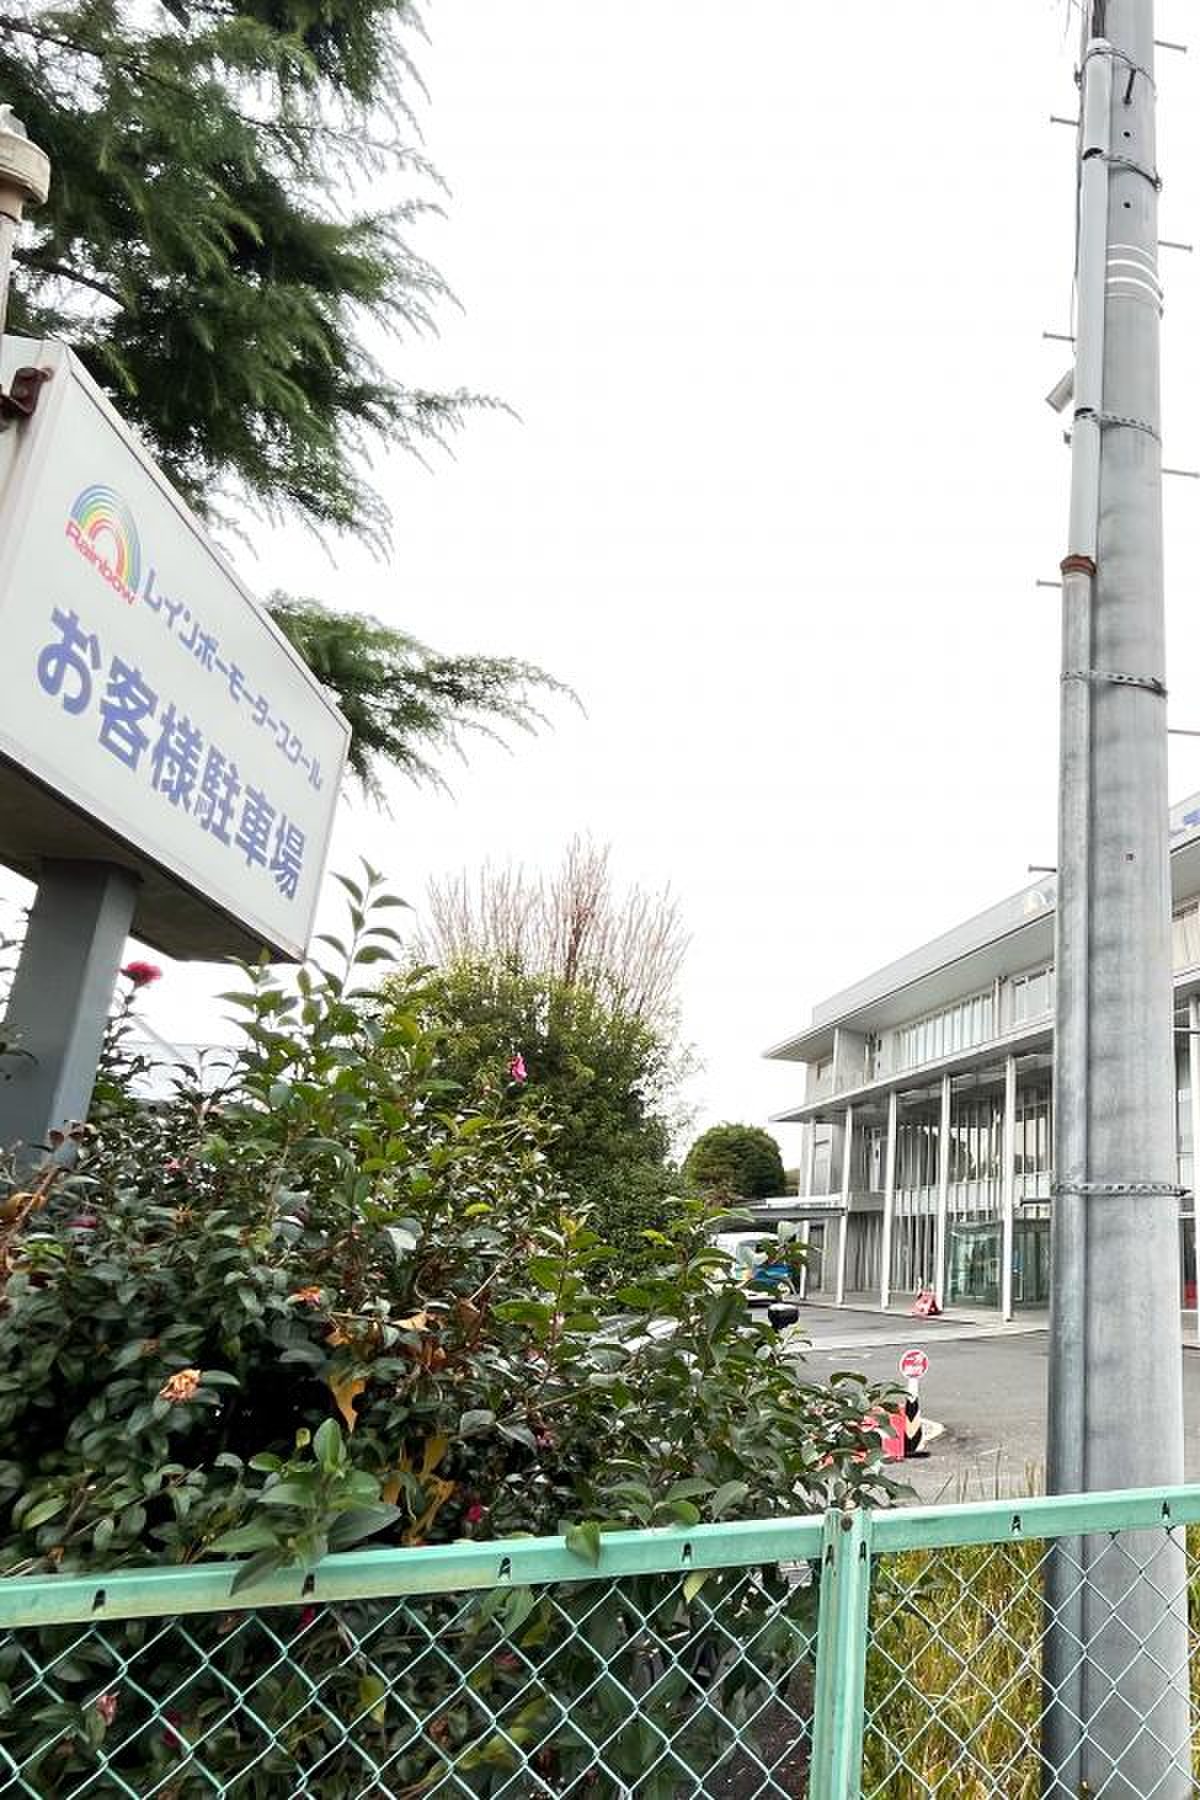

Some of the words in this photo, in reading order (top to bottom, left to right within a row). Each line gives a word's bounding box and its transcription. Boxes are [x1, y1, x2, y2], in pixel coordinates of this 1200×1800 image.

[65, 520, 135, 604] Rainbow
[37, 606, 304, 900] お客様駐車場
[144, 568, 322, 791] レインボーモータースクール
